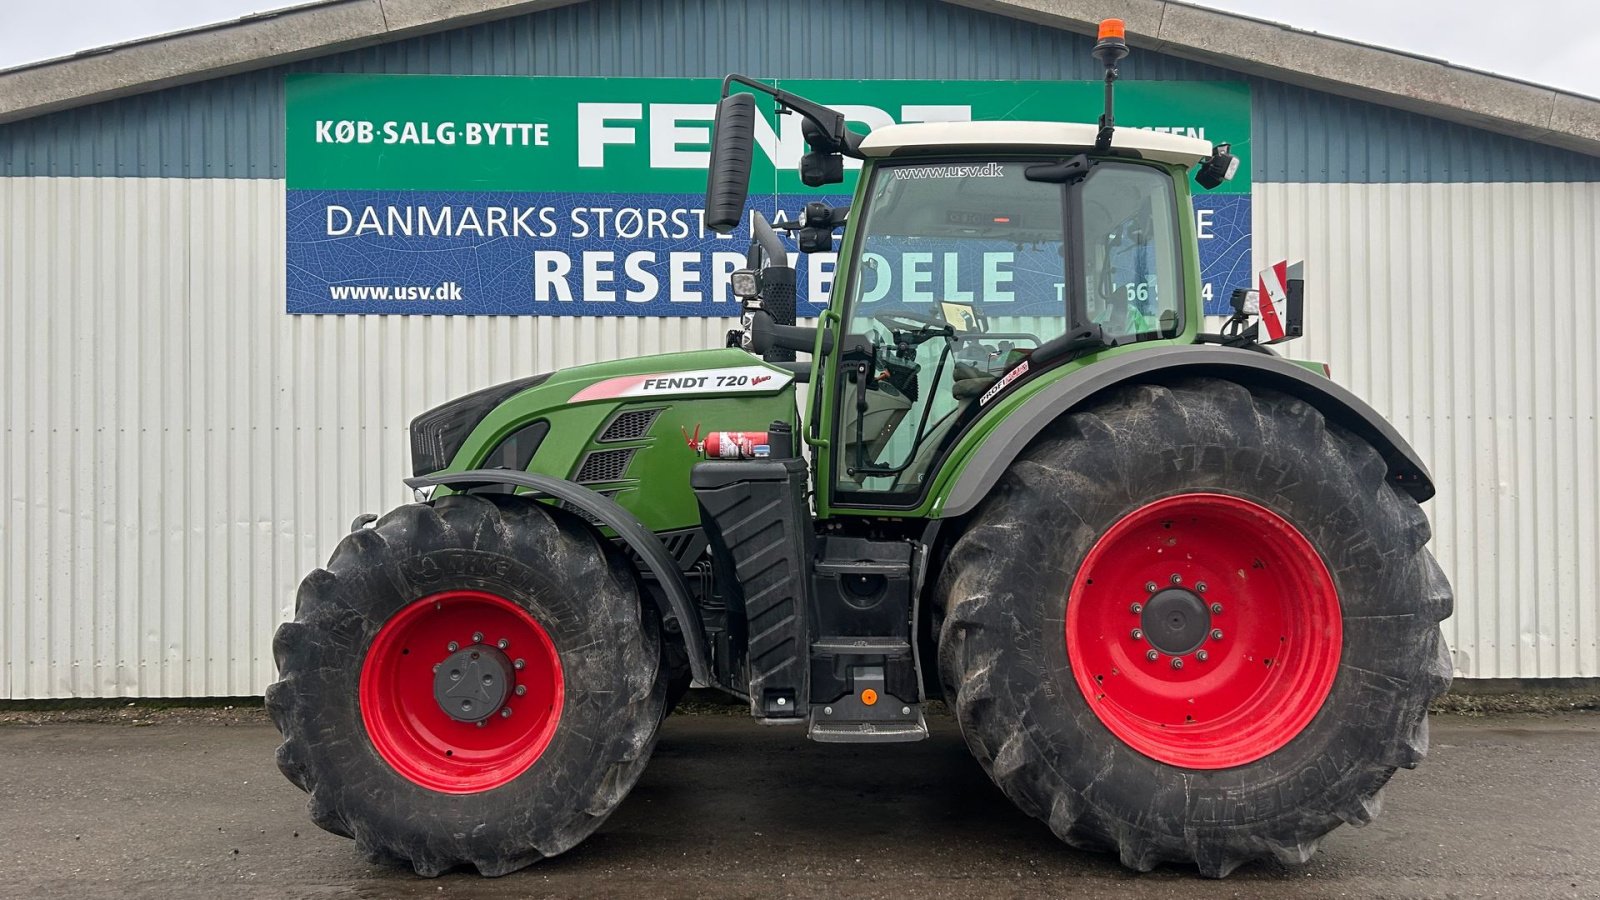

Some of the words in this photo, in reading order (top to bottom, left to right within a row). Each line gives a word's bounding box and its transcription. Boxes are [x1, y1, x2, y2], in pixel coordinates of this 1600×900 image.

[894, 163, 1003, 180] www.usv.dk
[326, 205, 556, 238] DANMARKS
[571, 208, 733, 239] STØRST
[534, 250, 1015, 303] RESEREDELE
[330, 282, 462, 302] www.usv.dk
[643, 376, 708, 390] FENDT
[716, 375, 748, 387] 720
